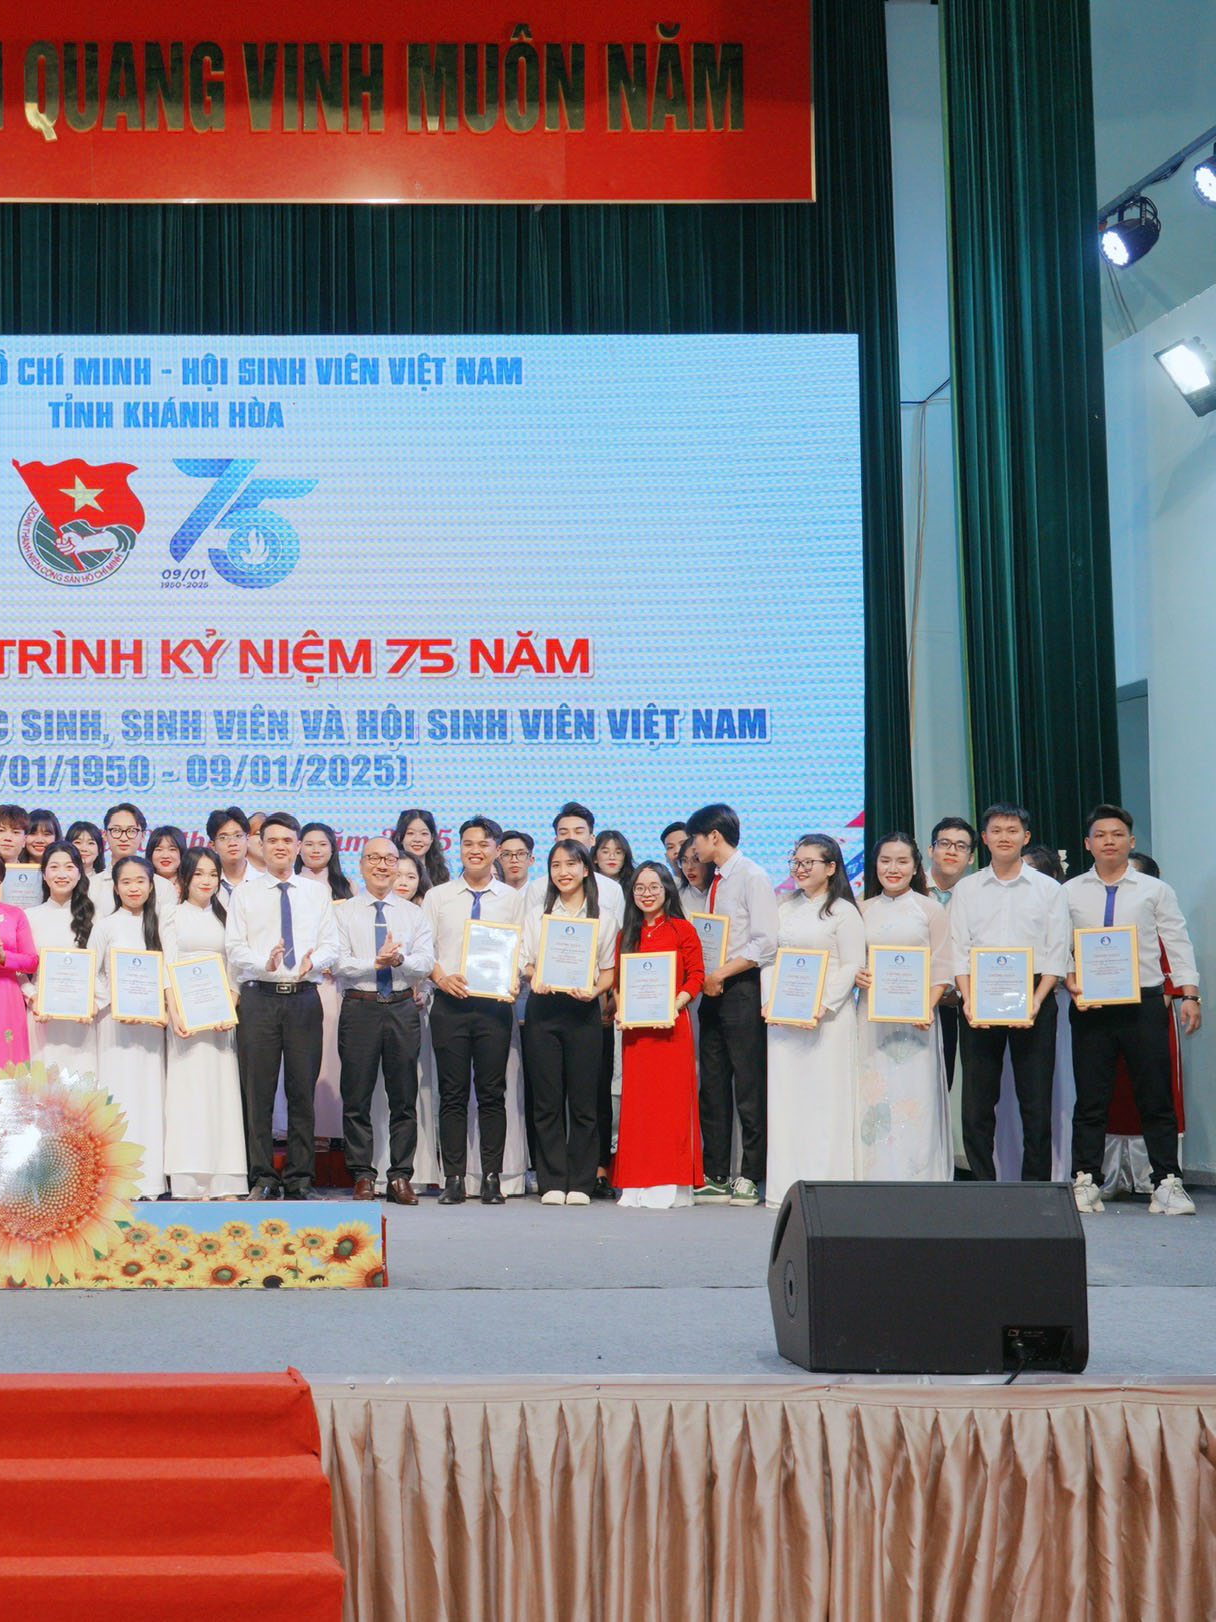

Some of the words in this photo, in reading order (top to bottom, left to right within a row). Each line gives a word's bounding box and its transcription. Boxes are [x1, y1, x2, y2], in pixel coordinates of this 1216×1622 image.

[24, 39, 226, 143] QUANG
[242, 42, 385, 134] VINH
[406, 22, 585, 135] MUÔN
[605, 22, 745, 134] NĂM
[18, 352, 65, 386] CHÍ
[74, 356, 152, 386] MINH
[182, 352, 229, 392] HỘI
[238, 356, 307, 386] SINH
[315, 352, 380, 386] VIÊN
[388, 352, 447, 392] VIỆT
[455, 356, 523, 386] NAM
[48, 392, 114, 429] TỈNH
[123, 396, 219, 429] KHÁNH
[229, 396, 285, 429] HÒA
[161, 567, 207, 582] 09/01
[160, 628, 226, 675] KỶ
[239, 629, 373, 684] NIỆM
[386, 638, 455, 674] 75
[469, 630, 590, 674] NĂM
[21, 708, 110, 746] SINH,
[121, 708, 202, 741] SINH
[213, 703, 289, 741] VIÊN
[300, 703, 346, 741] VÀ
[356, 703, 415, 747] HỘI
[427, 708, 508, 741] SINH
[519, 702, 595, 741] VIÊN
[606, 702, 680, 746] VIỆT
[692, 708, 768, 740] NAM
[186, 754, 409, 788] 09/01/2025)
[335, 829, 370, 852] ăm
